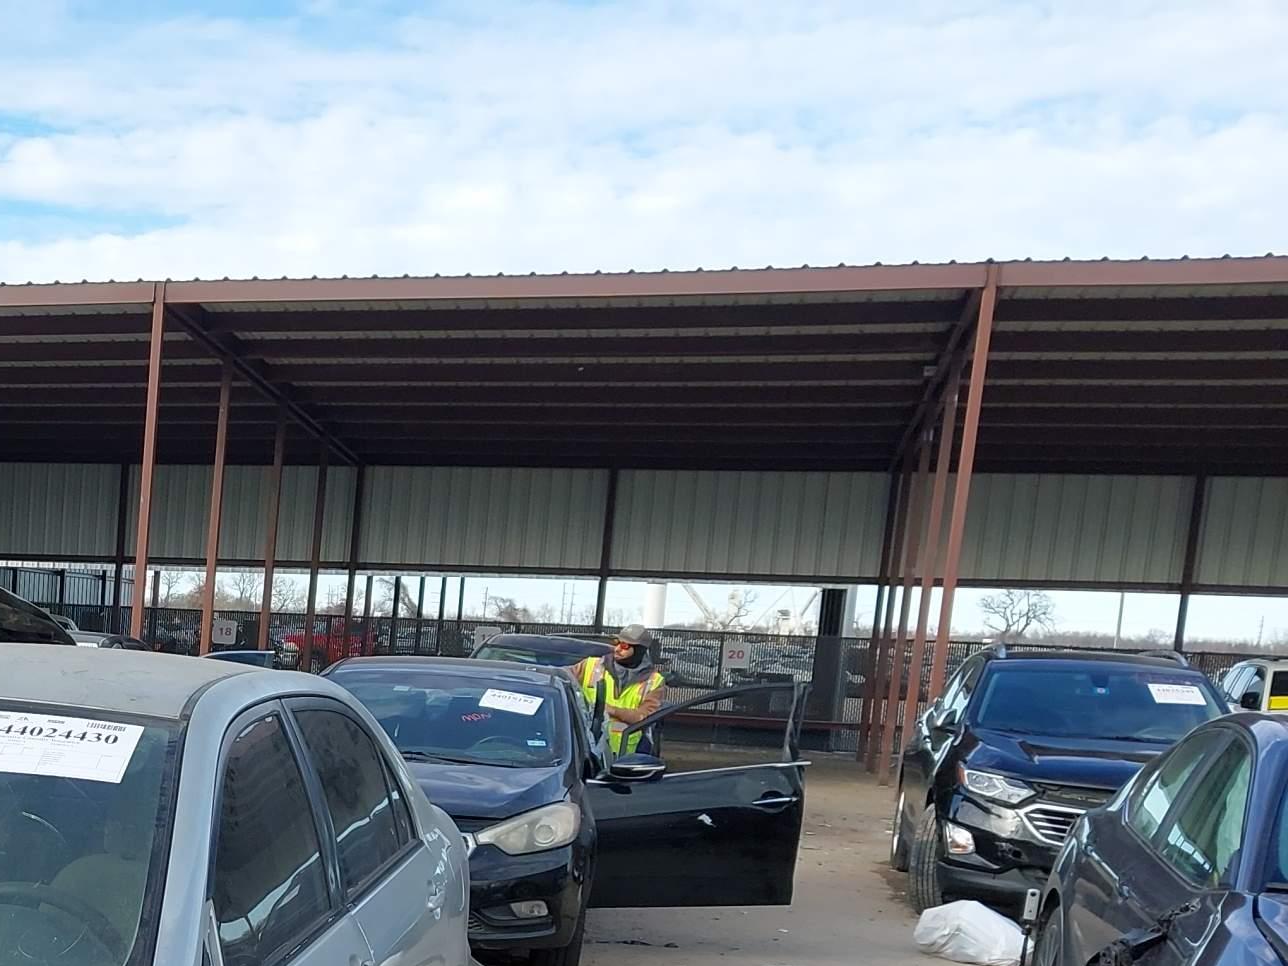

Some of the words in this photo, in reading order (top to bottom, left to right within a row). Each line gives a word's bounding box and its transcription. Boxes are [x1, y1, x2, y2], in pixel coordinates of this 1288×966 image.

[219, 627, 232, 636] 18
[728, 650, 745, 660] 20
[461, 712, 492, 721] MON
[0, 724, 119, 744] 44024430
